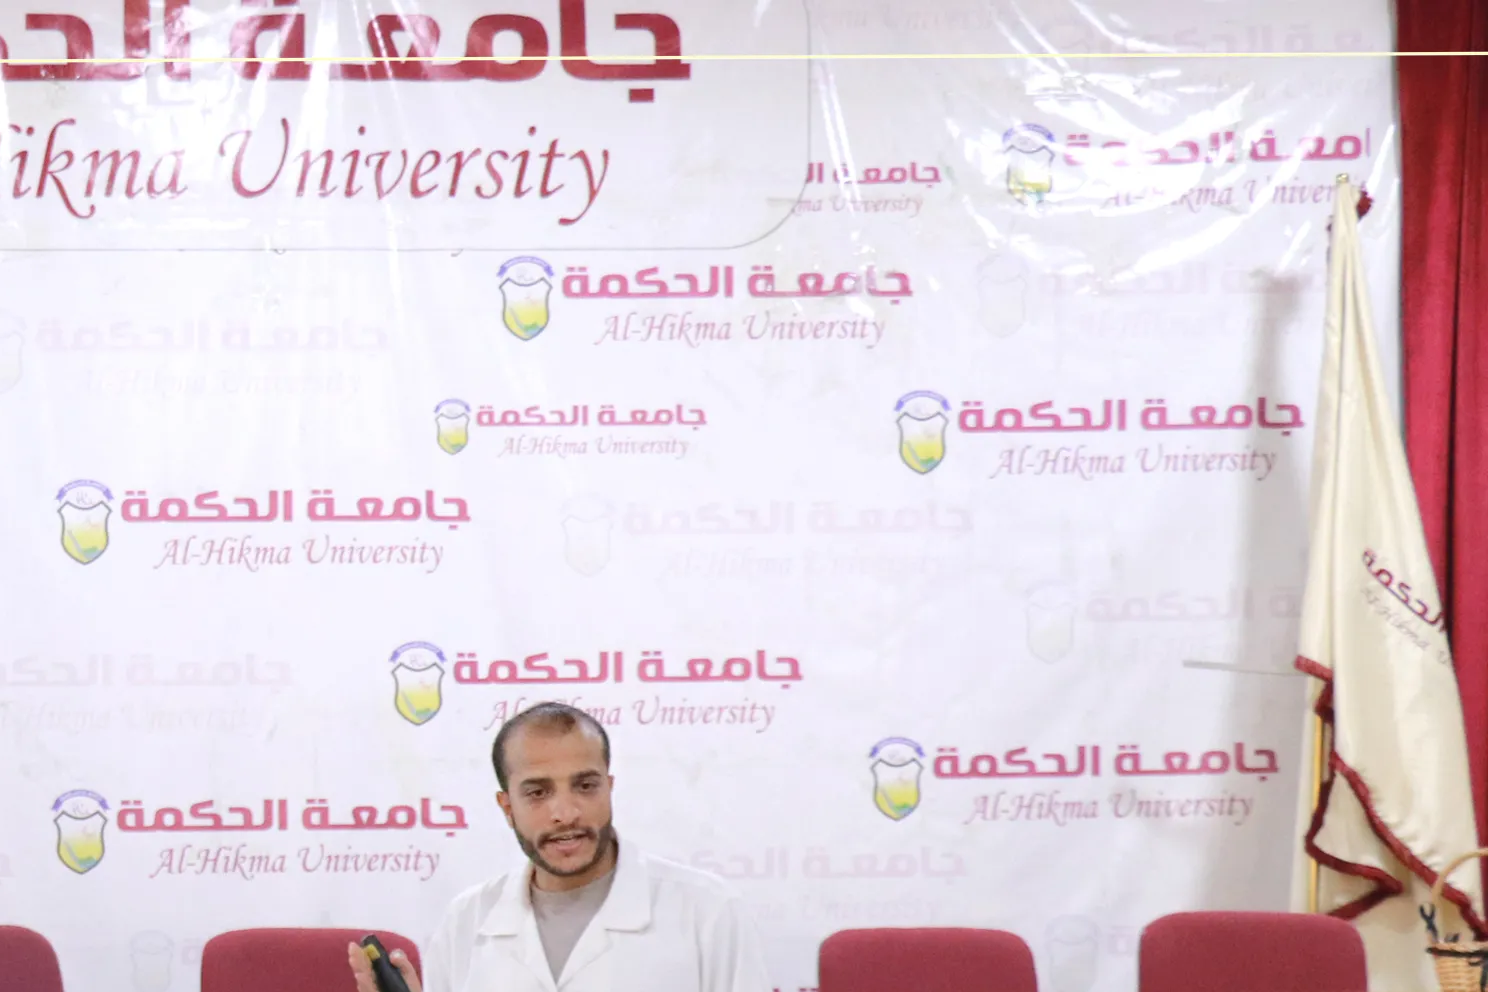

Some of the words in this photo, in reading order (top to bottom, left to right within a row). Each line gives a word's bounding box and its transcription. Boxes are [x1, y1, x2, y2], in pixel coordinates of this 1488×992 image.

[216, 118, 610, 226] University
[561, 264, 735, 300] الحكمة
[746, 264, 914, 306] جامعة
[593, 310, 733, 349] Al-Hikma
[742, 309, 886, 351] University
[475, 404, 590, 428] الحكمة
[595, 403, 708, 431] جامعة
[957, 398, 1128, 434] الحكمة
[1140, 397, 1304, 437] جامعة
[499, 433, 588, 459] Al-Hikma
[594, 434, 690, 461] University
[988, 444, 1126, 482] Al-Hikma
[1134, 443, 1276, 481] University
[120, 489, 294, 524] الحكمة
[306, 488, 472, 531] جامعة
[152, 533, 292, 573] Al-Hikma
[301, 533, 444, 575] University
[452, 650, 625, 686] الحكمة
[636, 648, 805, 690] جامعة
[631, 695, 776, 735] University
[931, 744, 1102, 780] الحكمة
[1114, 741, 1279, 781] جامعة
[115, 798, 289, 834] الحكمة
[300, 796, 470, 839] جامعة
[963, 789, 1100, 828] Al-Hikma
[1110, 788, 1254, 826] University
[148, 842, 287, 882] Al-Hikma
[296, 843, 441, 883] University
